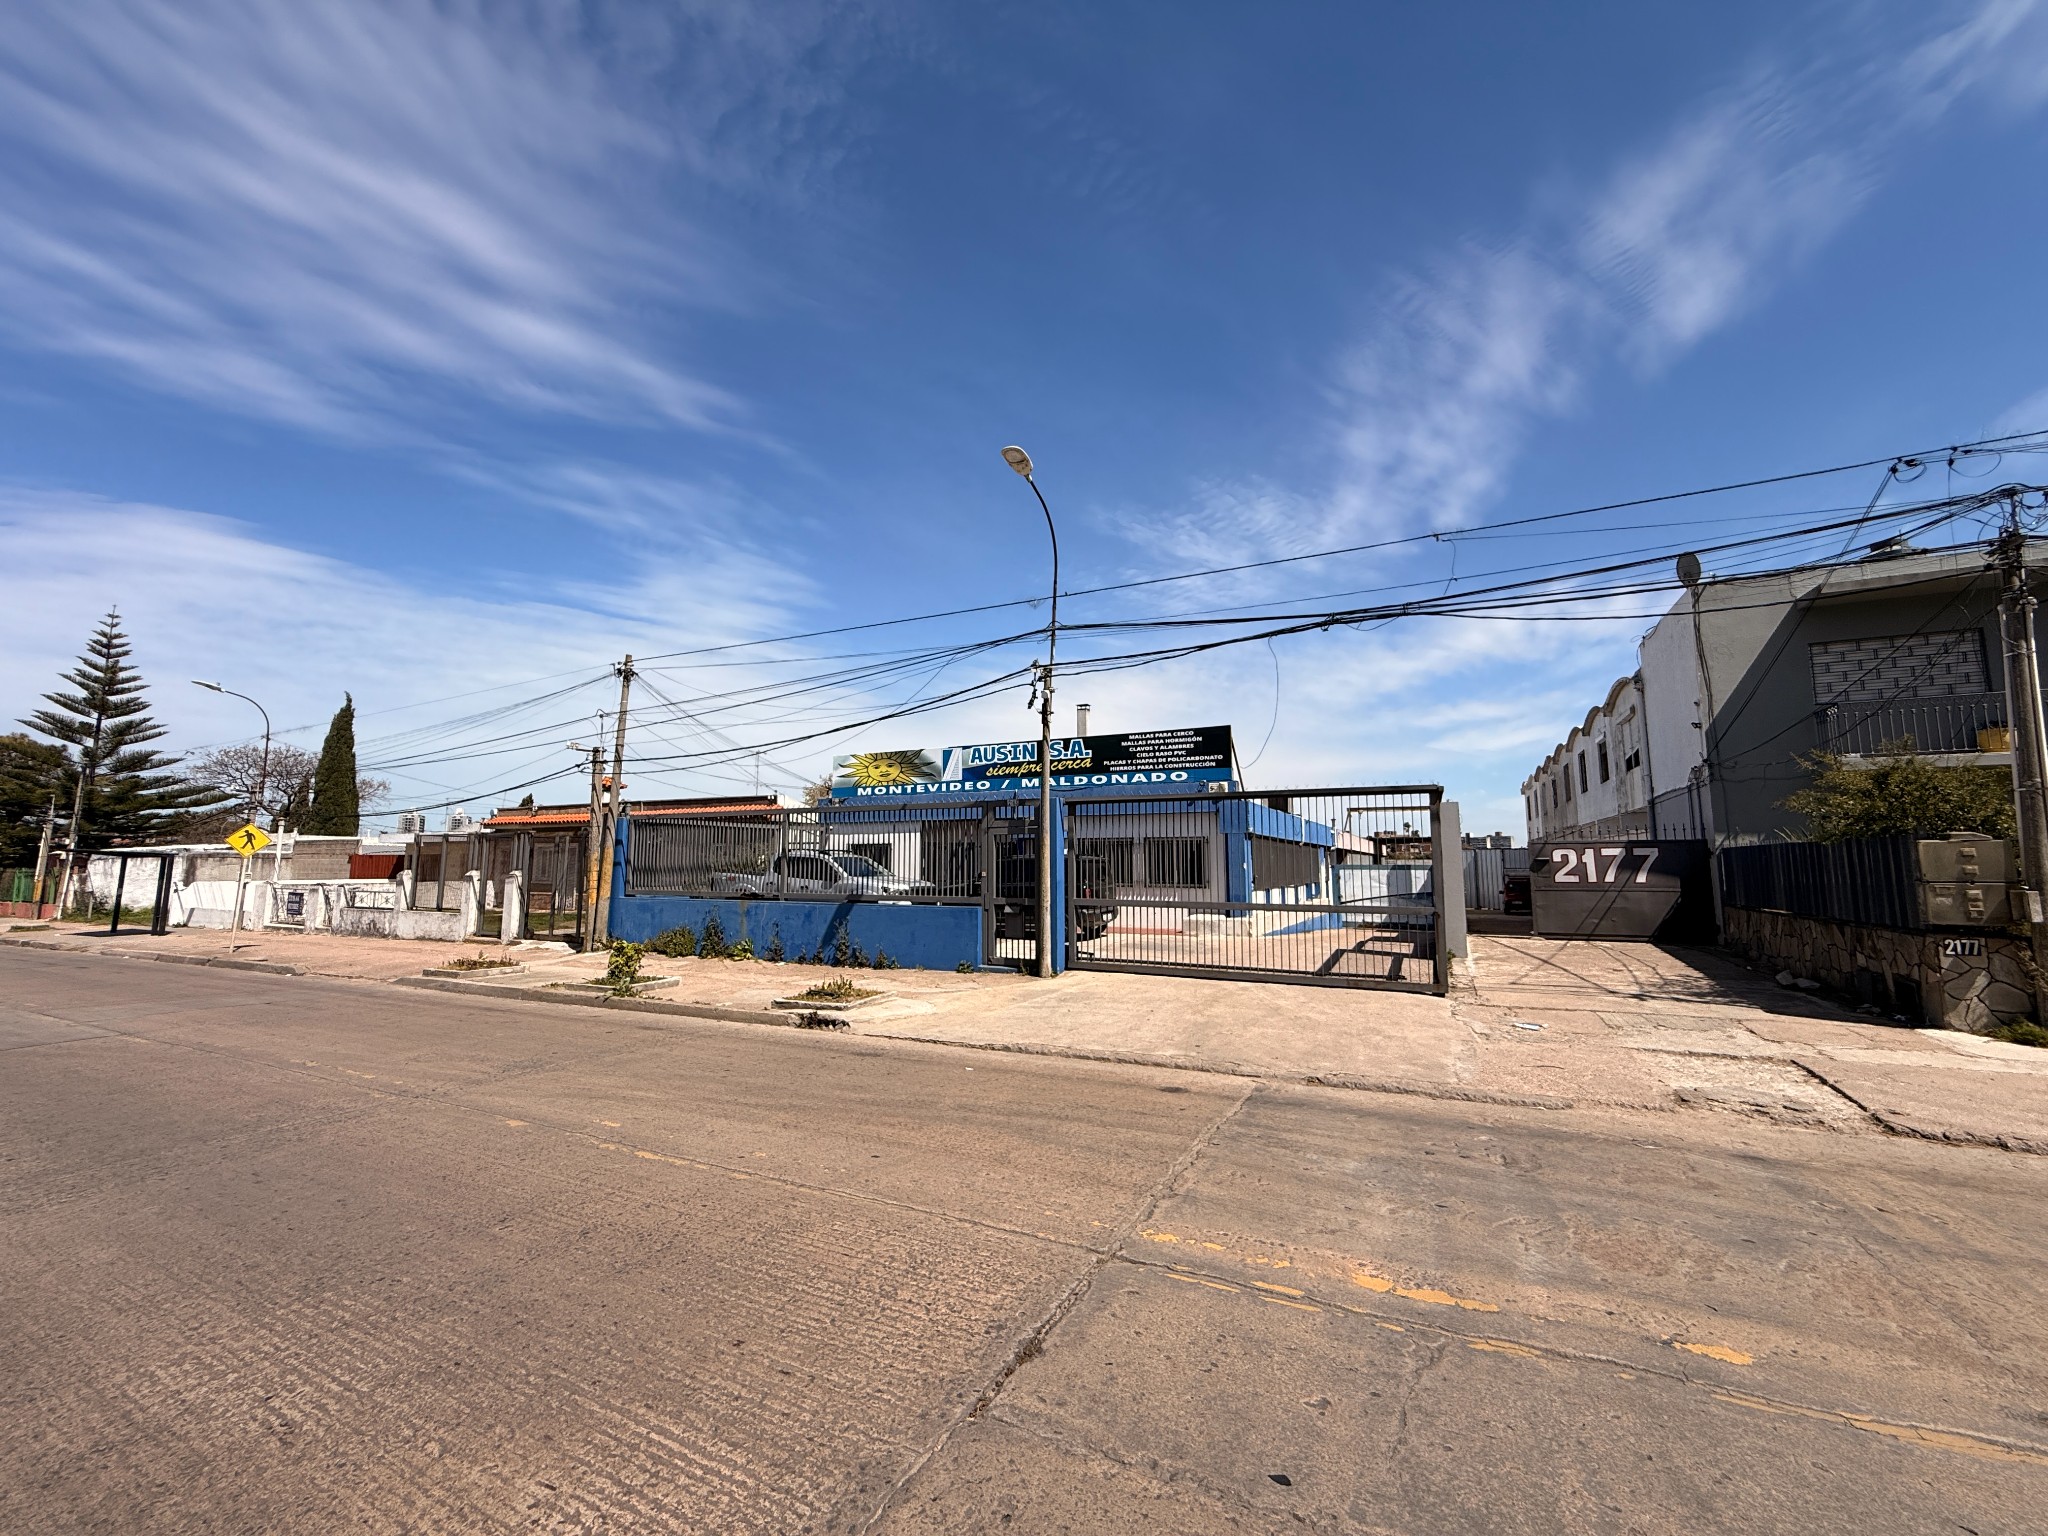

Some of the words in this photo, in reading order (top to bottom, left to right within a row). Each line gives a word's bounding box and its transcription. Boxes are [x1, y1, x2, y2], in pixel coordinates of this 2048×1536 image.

[968, 742, 1038, 765] AUSIN
[1049, 738, 1093, 760] S.A.
[1167, 754, 1223, 762] POLICARBONATO
[985, 762, 1043, 777] siempre
[1050, 757, 1094, 770] cerca
[1164, 761, 1216, 769] CONSTRUCCIÓN
[857, 780, 991, 796] MONTEVIDEO
[1552, 847, 1659, 883] 2177
[1944, 939, 1979, 955] 2177
